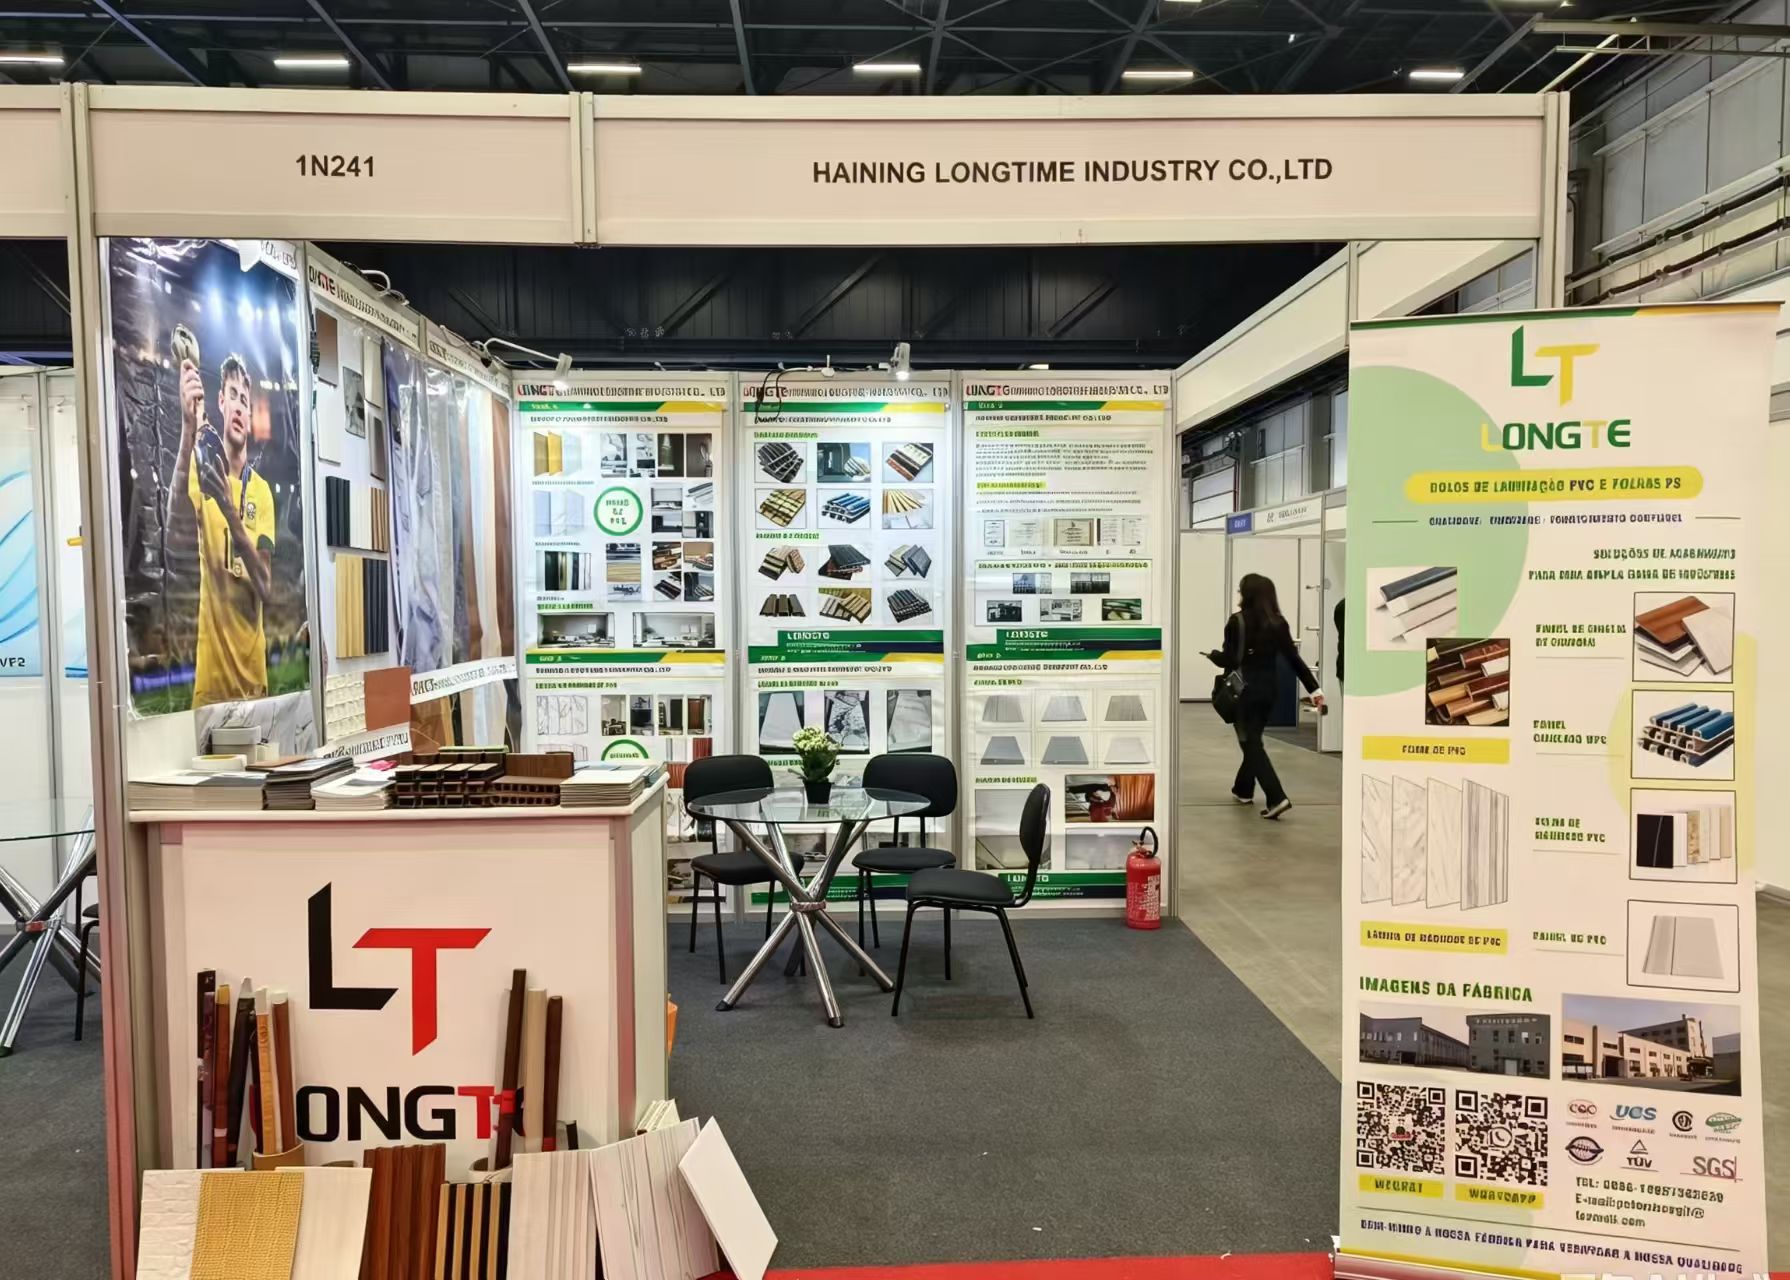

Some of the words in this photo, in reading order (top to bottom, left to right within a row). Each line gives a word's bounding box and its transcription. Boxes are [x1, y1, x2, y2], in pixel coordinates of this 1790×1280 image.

[296, 154, 374, 177] 1N241
[813, 161, 926, 184] HAINING
[935, 161, 1076, 183] LONGTIME
[1084, 159, 1220, 182] INDUSTRY
[1228, 158, 1333, 184] CO.,LTD
[1480, 418, 1631, 453] LONGTE
[1600, 478, 1608, 490] E
[1359, 975, 1431, 996] IMAGENS
[1436, 982, 1457, 997] DA
[1692, 1155, 1736, 1180] SGS
